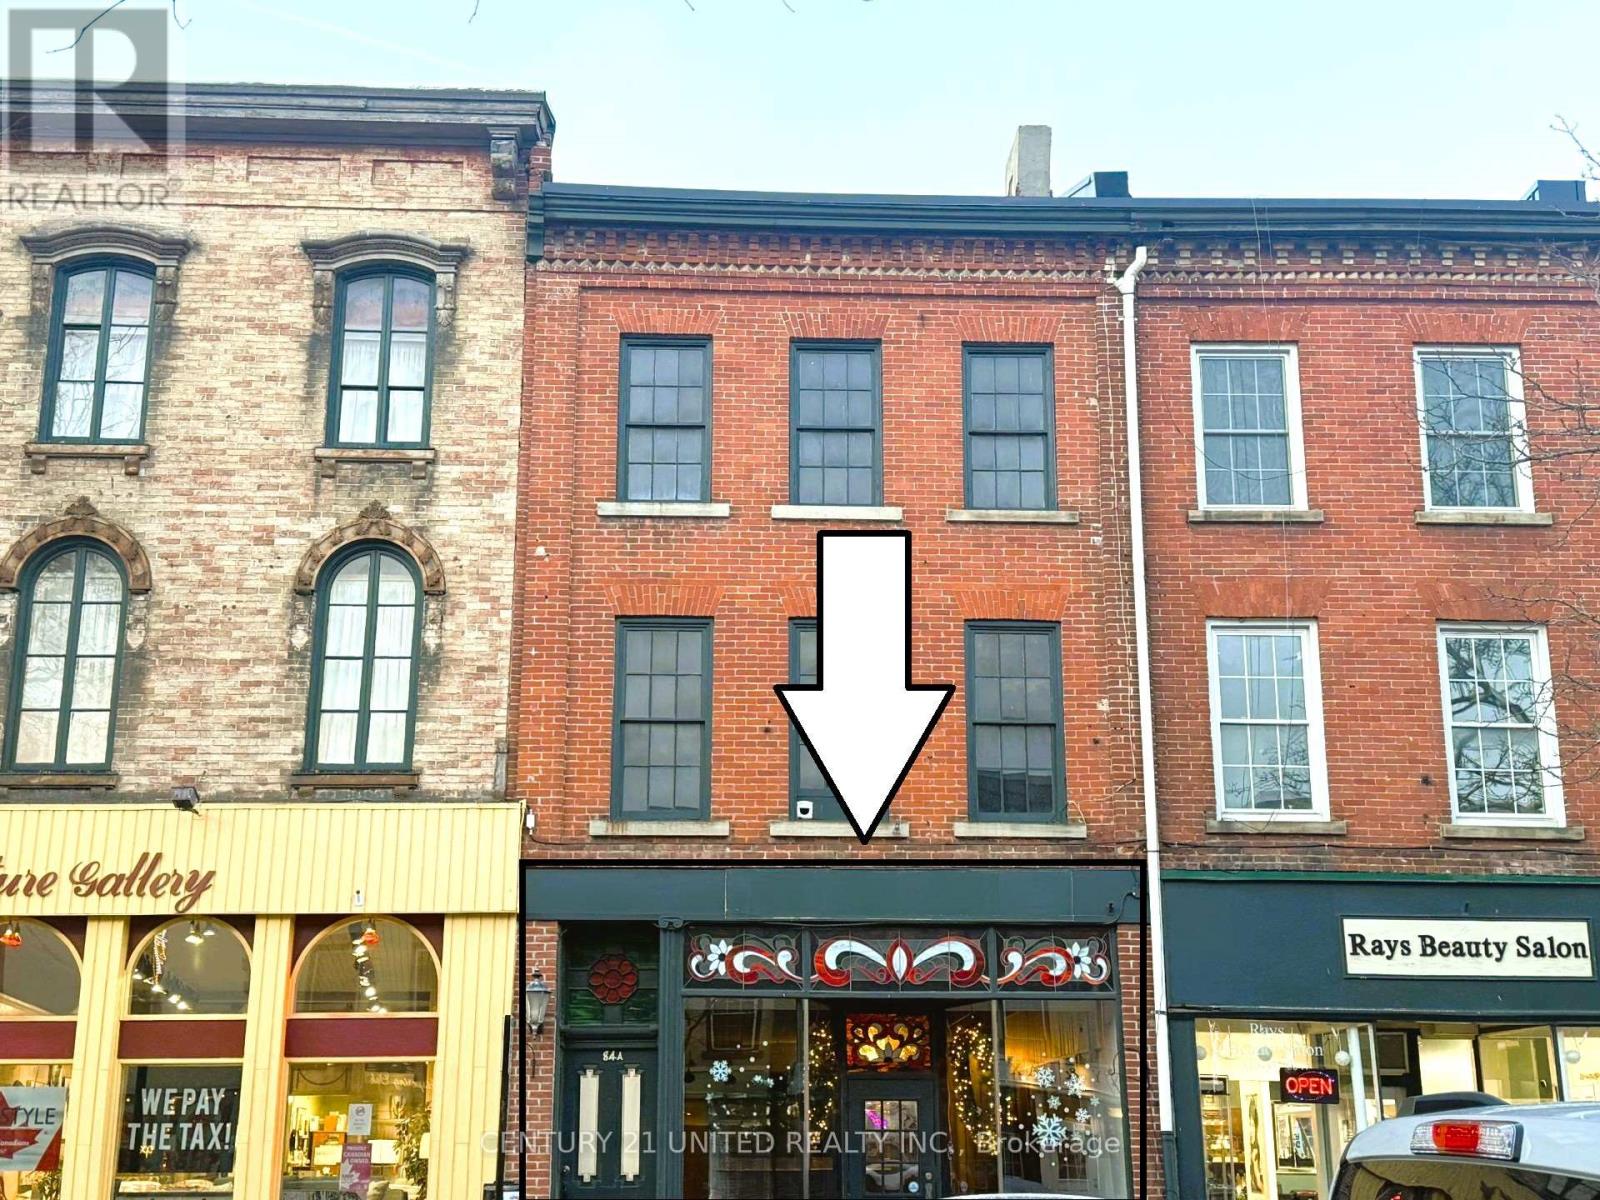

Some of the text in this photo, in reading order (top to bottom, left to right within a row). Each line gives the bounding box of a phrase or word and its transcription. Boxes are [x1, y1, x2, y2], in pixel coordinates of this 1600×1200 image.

[69, 851, 216, 913] Gallery
[1348, 933, 1589, 962] Rays Beauty Salon
[1286, 1076, 1332, 1095] OPEN
[141, 1088, 226, 1116] WE PAY
[128, 1122, 232, 1151] THE TAX!
